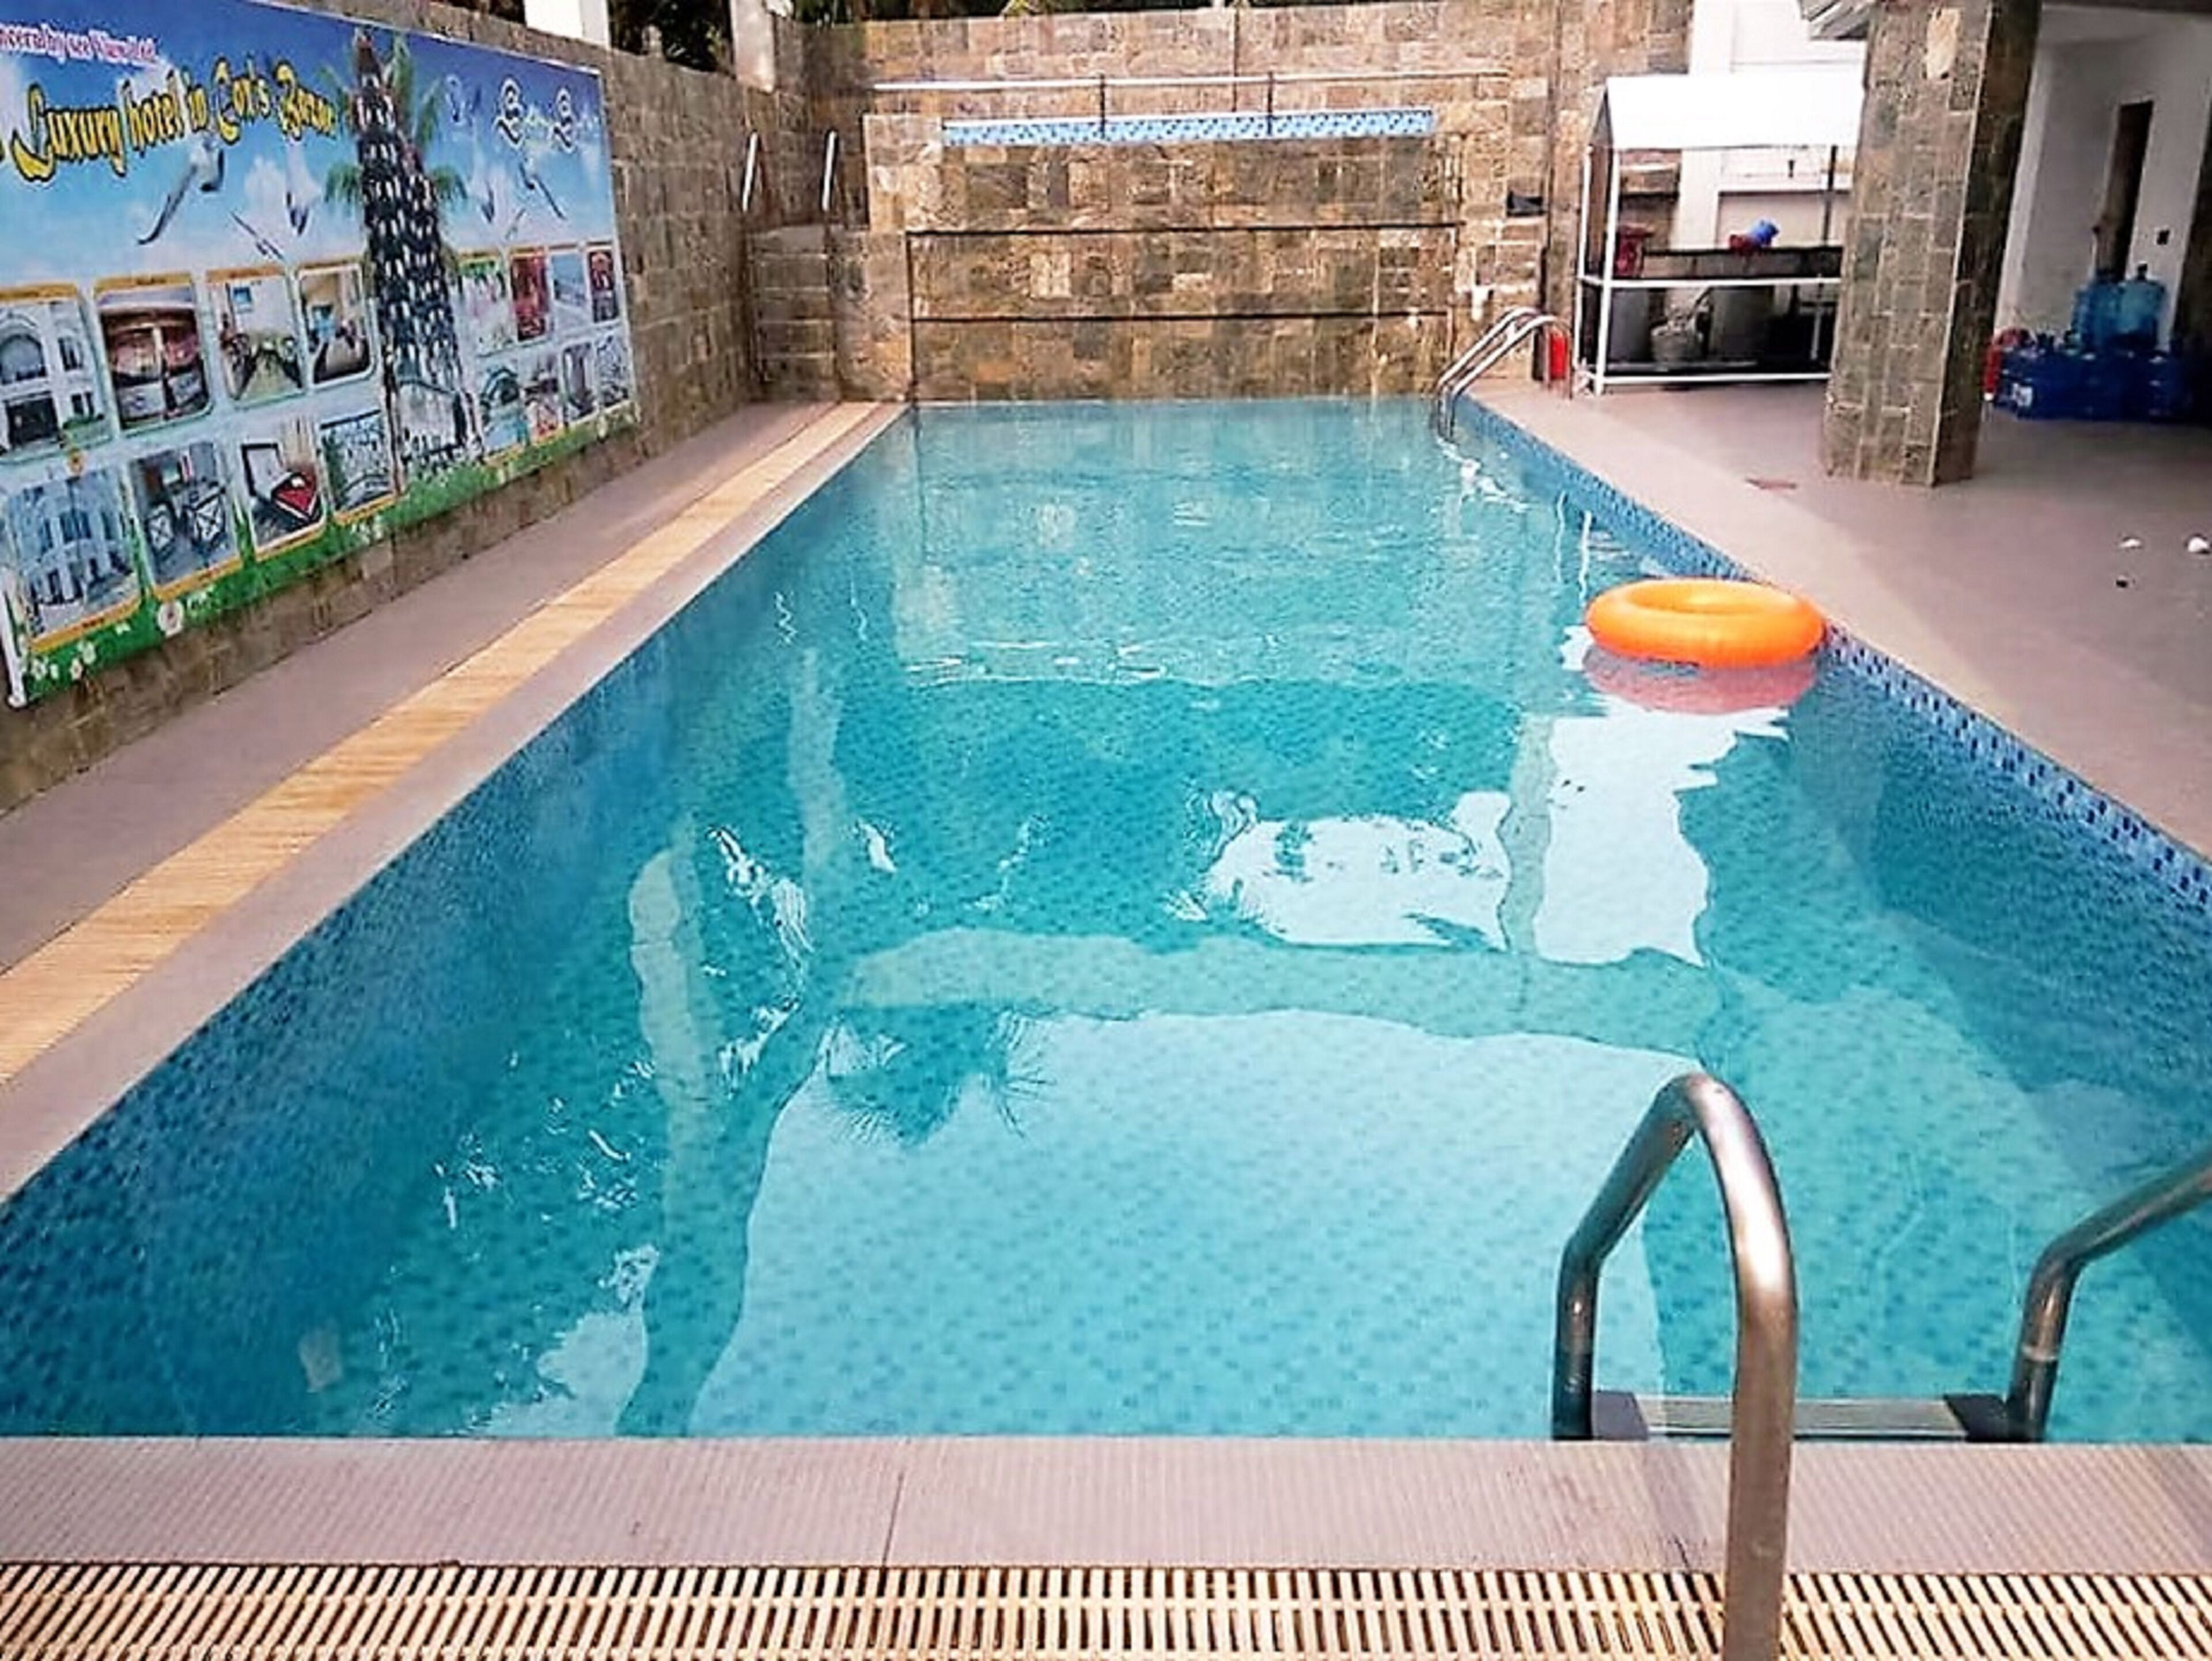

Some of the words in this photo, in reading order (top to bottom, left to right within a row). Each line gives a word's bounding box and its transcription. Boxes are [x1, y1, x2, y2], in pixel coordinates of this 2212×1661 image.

[10, 82, 127, 183] Luxury
[121, 69, 185, 159] hotel
[182, 68, 209, 133] in
